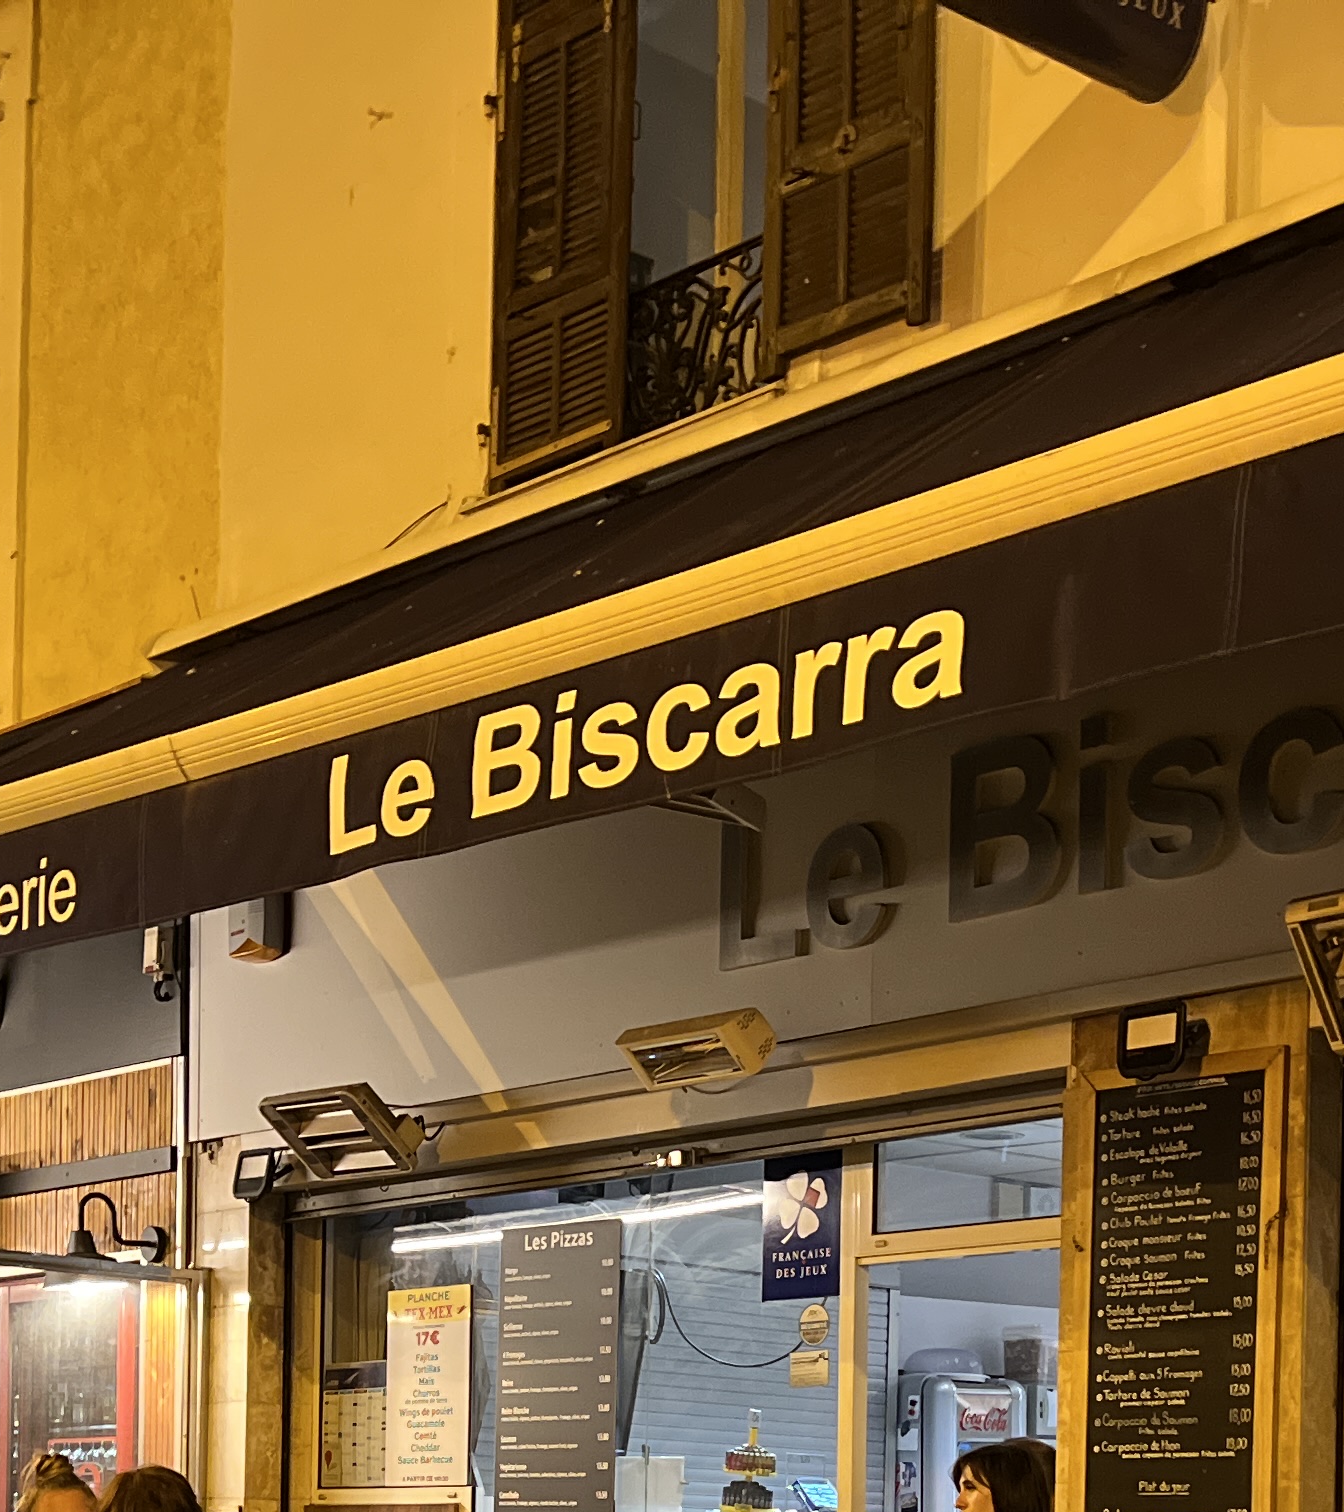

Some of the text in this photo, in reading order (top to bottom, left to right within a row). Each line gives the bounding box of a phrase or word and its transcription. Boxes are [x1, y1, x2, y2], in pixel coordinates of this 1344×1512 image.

[328, 608, 967, 858] Le Biscarra
[718, 795, 899, 973] Le
[1110, 1173, 1146, 1186] Burger
[1162, 1186, 1172, 1198] de
[1110, 1216, 1131, 1229] Club
[524, 1230, 594, 1252] Les Pizzas
[772, 1247, 832, 1263] FRANÇAISE
[775, 1264, 828, 1279] DES JEUX
[408, 1291, 450, 1303] PLANCHE
[416, 1330, 440, 1346] 17€
[1140, 1388, 1151, 1399] de
